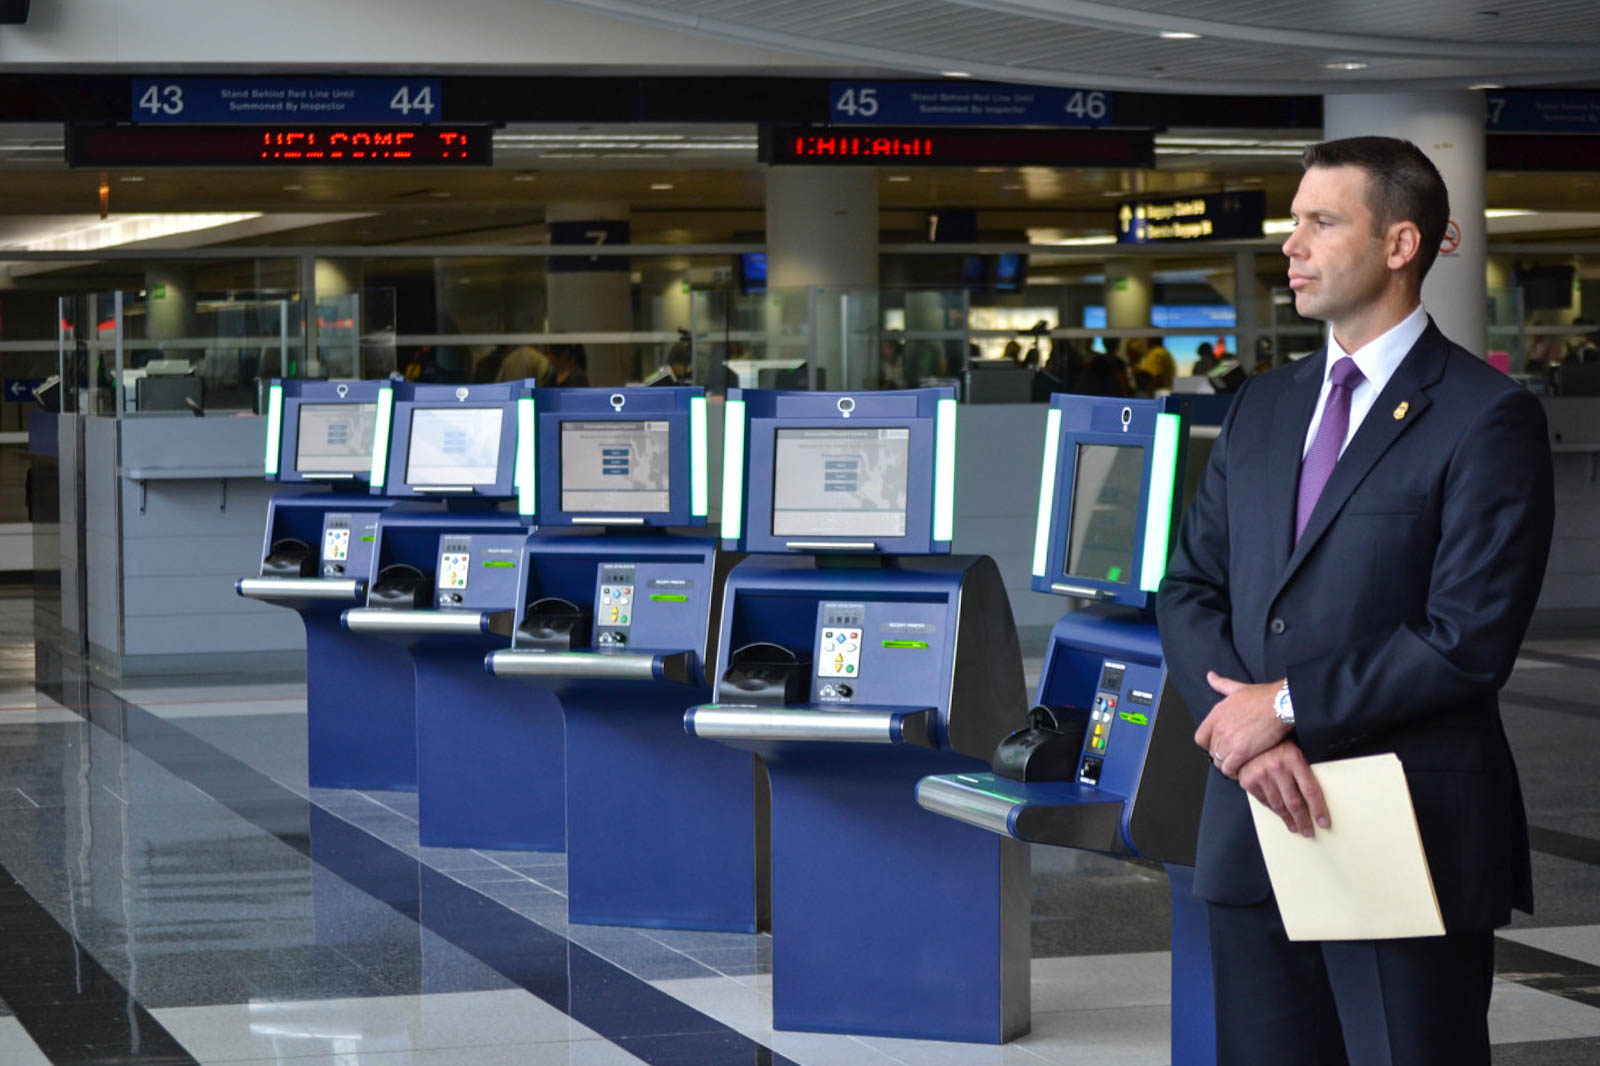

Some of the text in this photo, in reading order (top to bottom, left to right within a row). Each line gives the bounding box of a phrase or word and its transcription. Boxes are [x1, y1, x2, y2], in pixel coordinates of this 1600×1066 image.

[139, 85, 184, 115] 43
[221, 89, 354, 98] Stand Behind Red Line Until
[229, 102, 345, 112] Summoned By Inspector
[390, 86, 435, 115] 44
[836, 88, 879, 116] 45
[1065, 92, 1107, 119] 46
